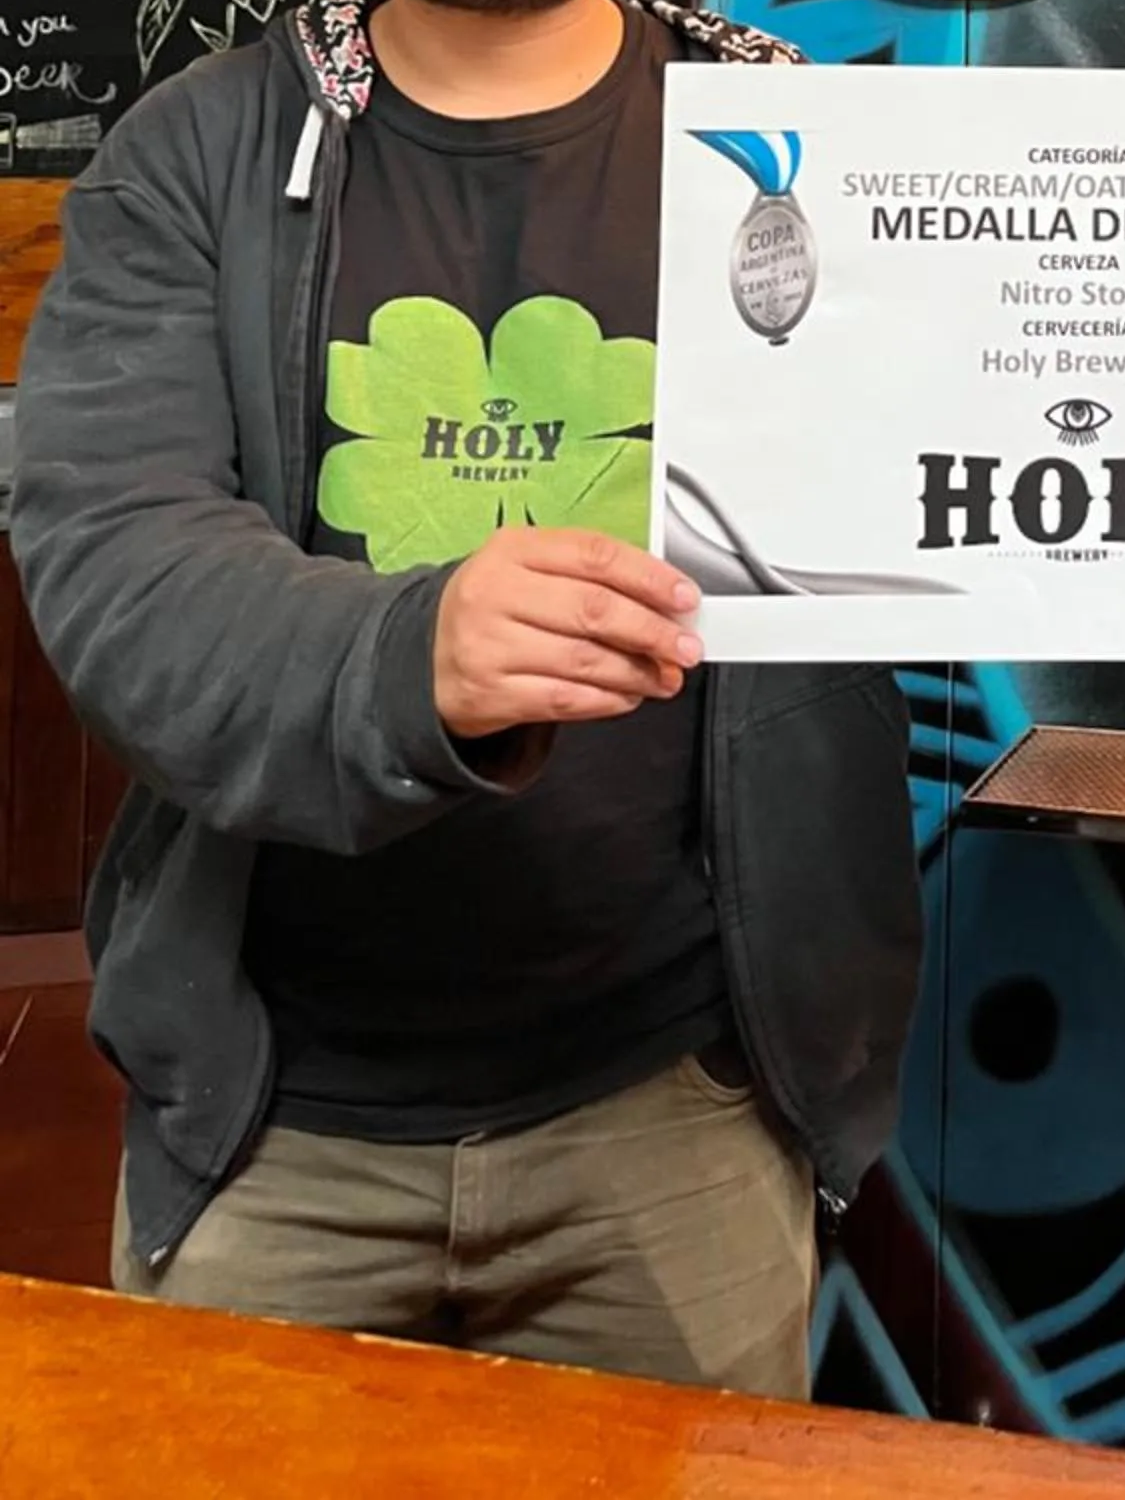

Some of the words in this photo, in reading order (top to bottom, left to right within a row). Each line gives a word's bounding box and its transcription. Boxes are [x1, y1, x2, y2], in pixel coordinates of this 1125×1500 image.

[17, 14, 77, 48] you
[747, 223, 796, 252] COPA
[870, 206, 1078, 242] MEDALLA
[1038, 254, 1120, 271] CERVEZA
[1000, 280, 1073, 306] Nitro
[981, 348, 1047, 379] Holy
[421, 417, 565, 461] HOLY
[451, 465, 529, 482] BREWERY
